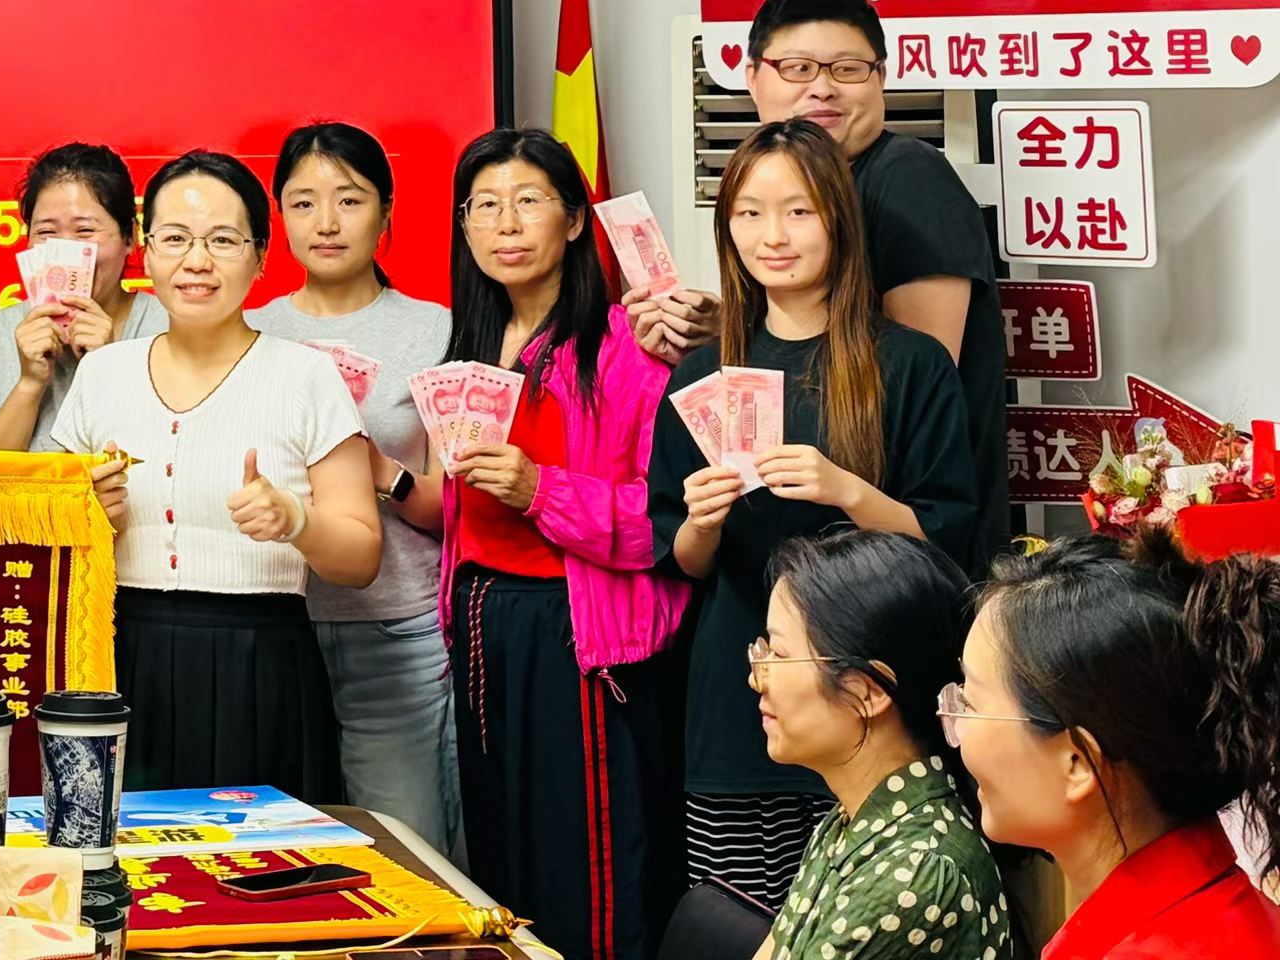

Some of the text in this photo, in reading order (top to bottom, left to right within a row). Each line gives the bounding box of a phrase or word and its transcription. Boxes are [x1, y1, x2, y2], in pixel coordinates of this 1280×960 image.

[897, 28, 1212, 79] 风吹到了这里
[1017, 115, 1121, 170] 全力
[1024, 196, 1128, 252] 以赴
